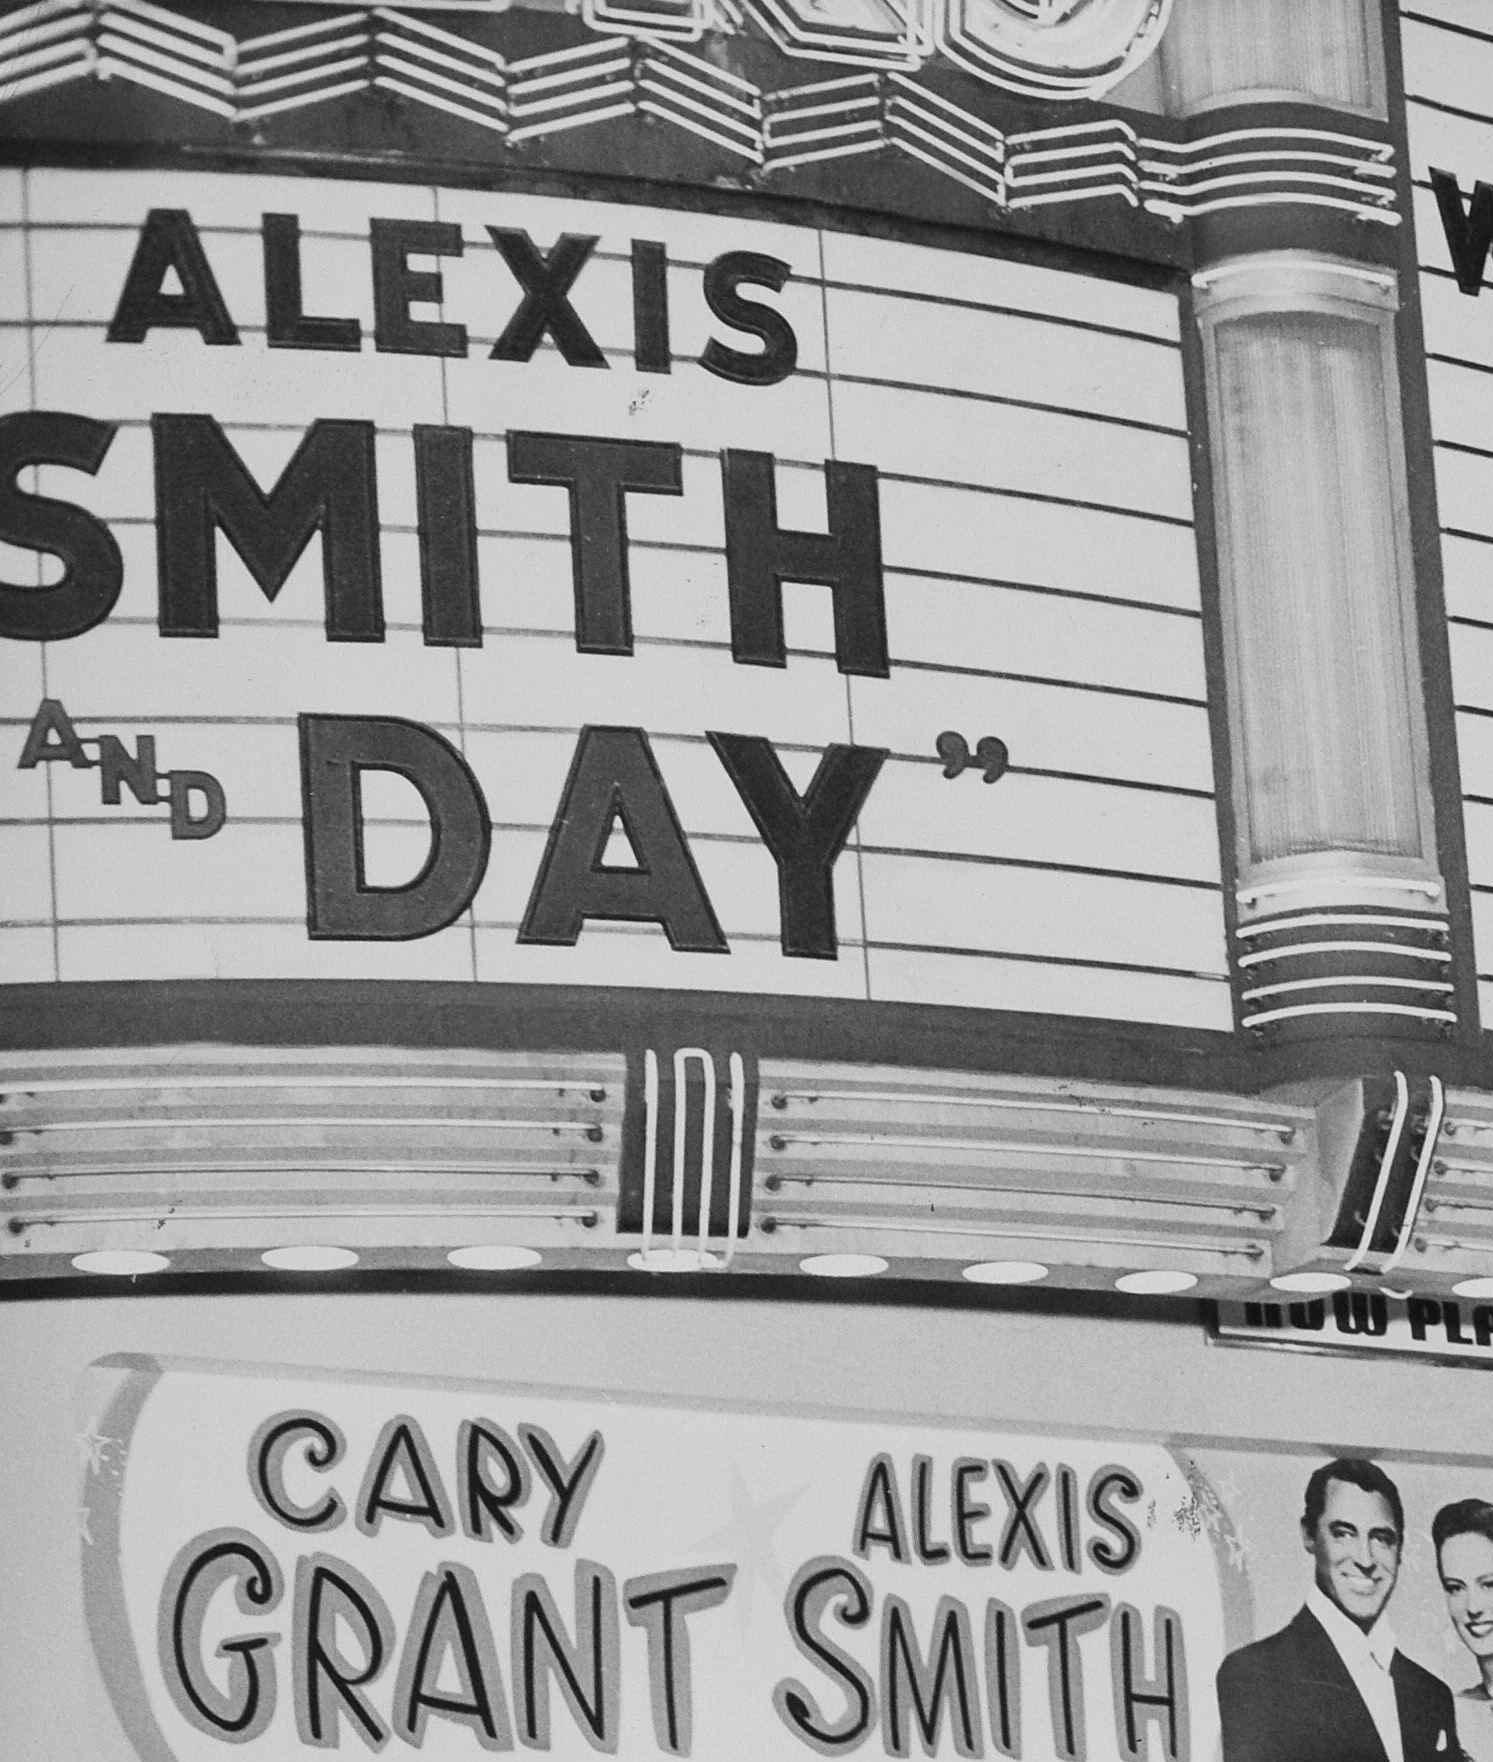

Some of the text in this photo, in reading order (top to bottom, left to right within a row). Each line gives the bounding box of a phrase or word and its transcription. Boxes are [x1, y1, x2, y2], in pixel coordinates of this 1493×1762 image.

[106, 208, 799, 386] ALEXIS
[0, 411, 890, 678] SMITH
[19, 698, 228, 841] AND
[246, 1409, 605, 1548] CARY
[851, 1452, 1157, 1574] ALEXIS
[156, 1527, 739, 1760] GRANT
